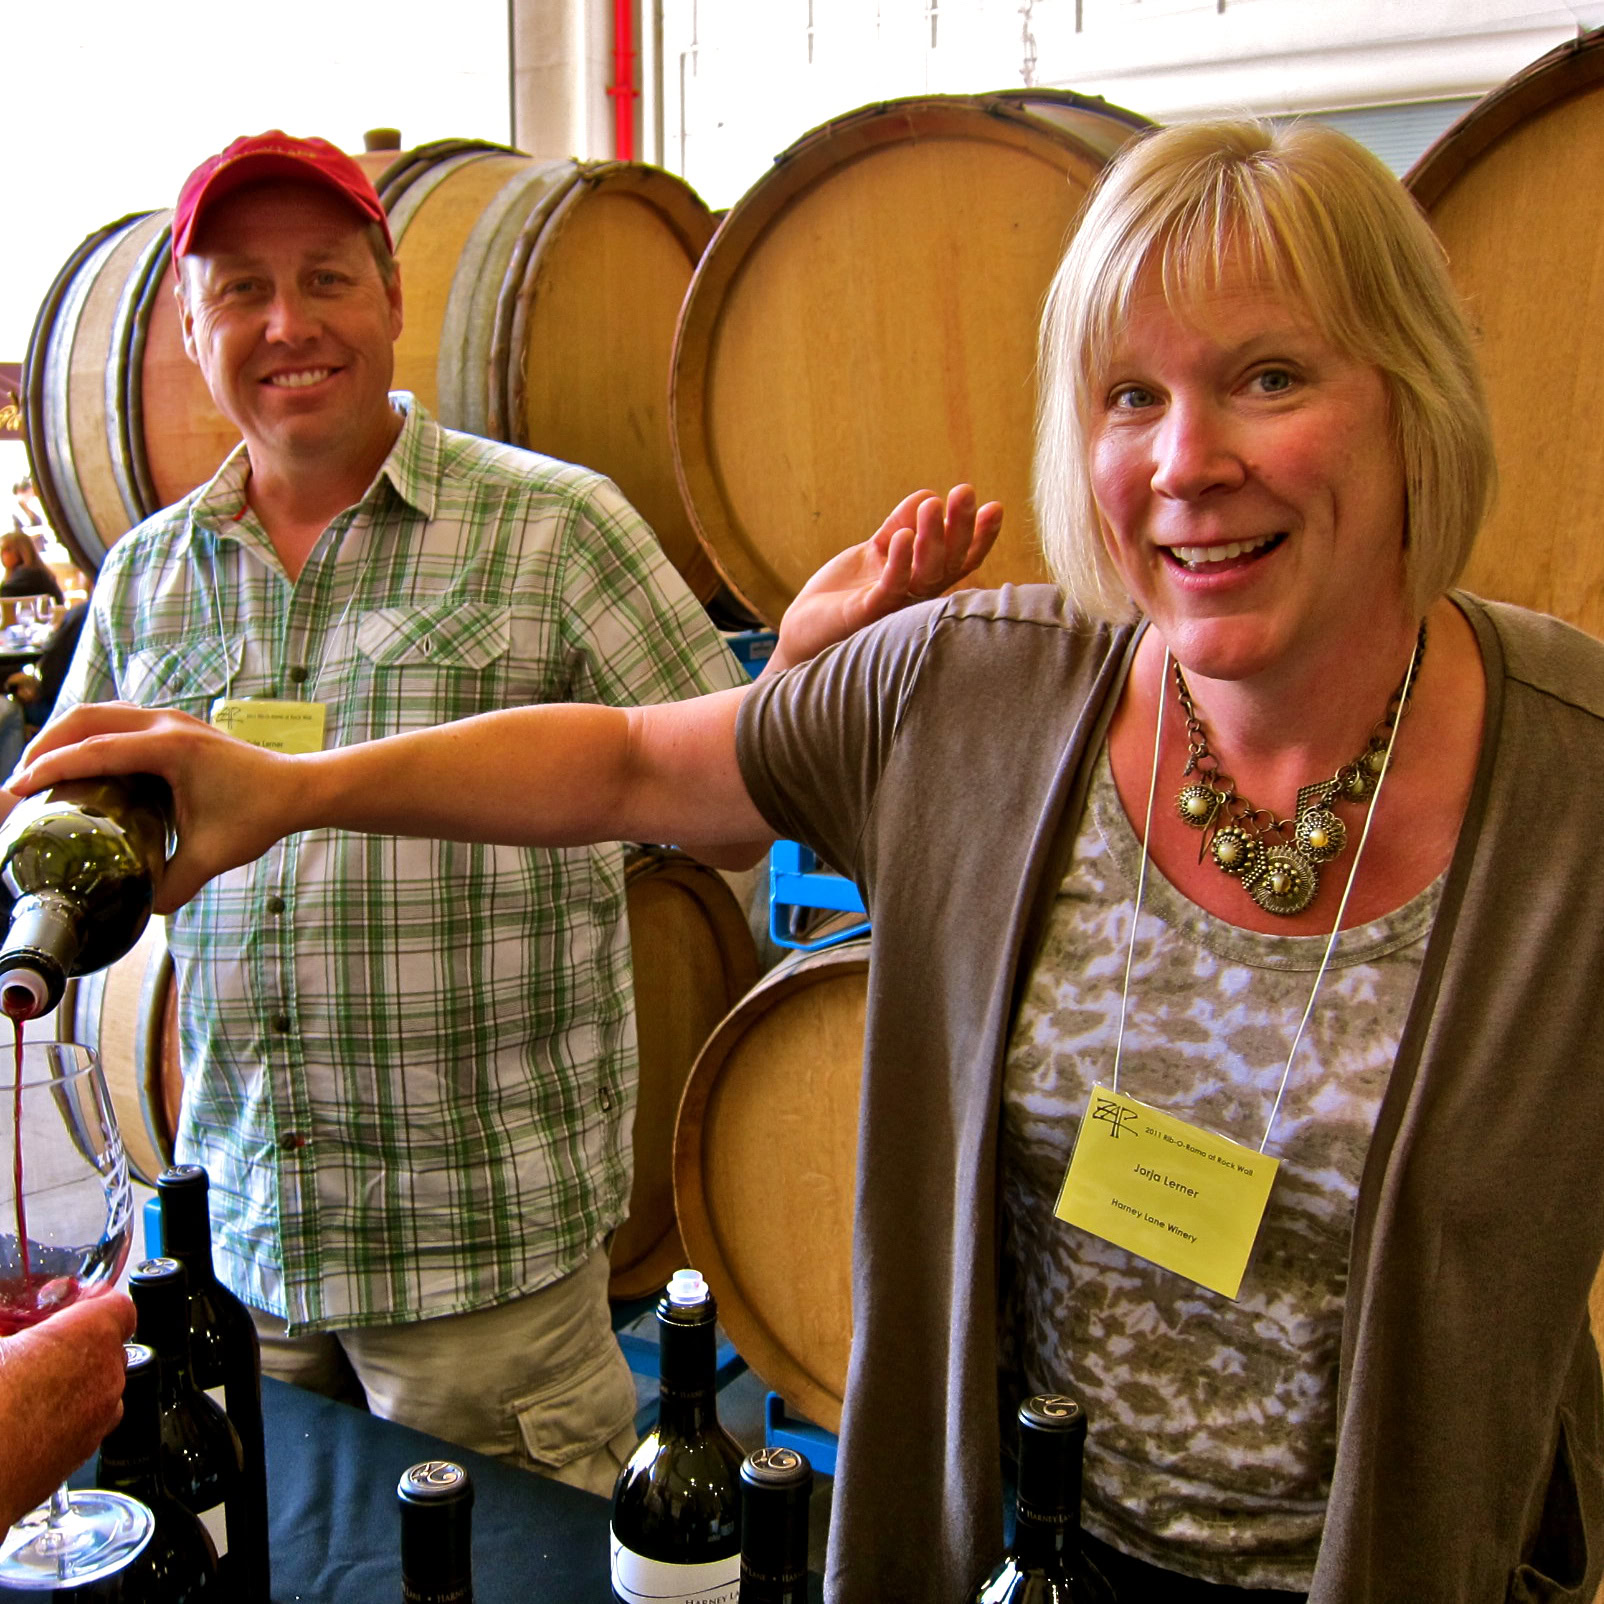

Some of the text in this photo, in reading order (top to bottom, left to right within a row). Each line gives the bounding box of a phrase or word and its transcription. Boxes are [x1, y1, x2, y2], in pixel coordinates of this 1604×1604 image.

[1092, 1097, 1139, 1138] ZAP
[1145, 1126, 1254, 1177] 2011 Rib-O-Rama at Rock Wall
[1133, 1163, 1200, 1198] Jorja Lerner
[1111, 1198, 1198, 1244] Harney Lane Winery
